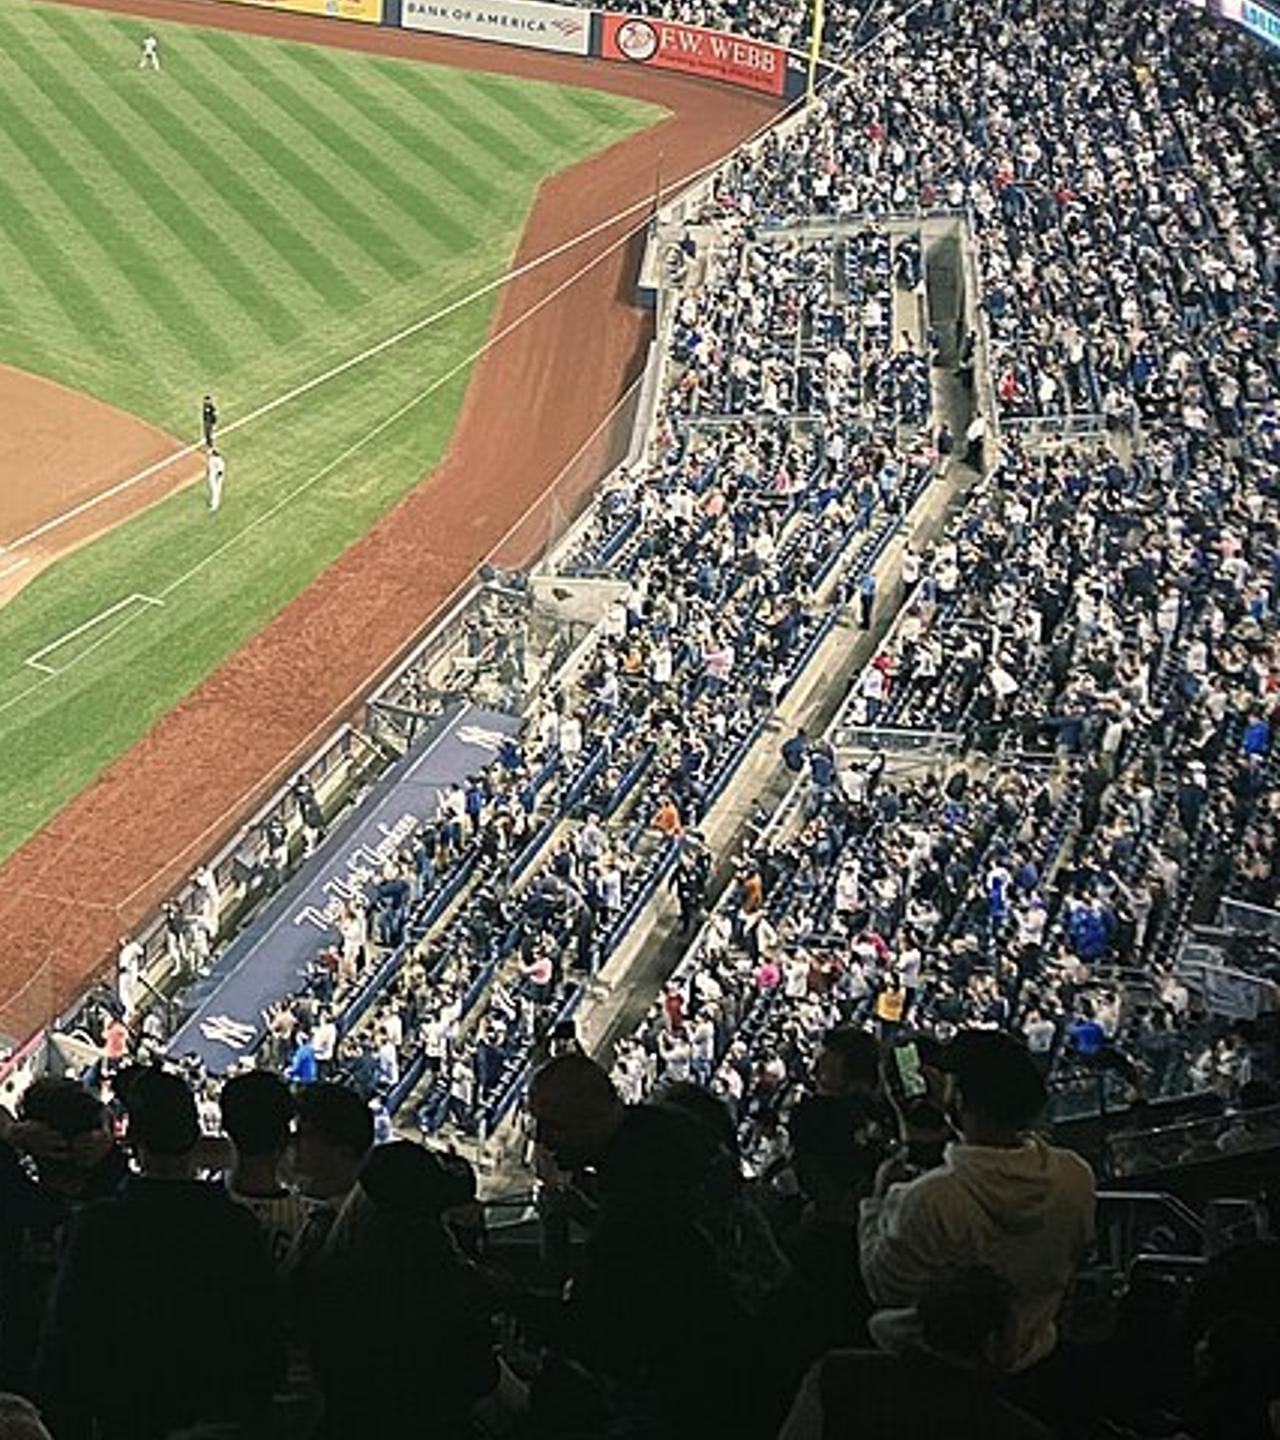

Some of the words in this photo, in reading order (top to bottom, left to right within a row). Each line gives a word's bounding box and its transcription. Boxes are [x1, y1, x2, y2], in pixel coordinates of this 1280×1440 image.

[407, 2, 447, 20] BANK
[451, 8, 471, 22] OF
[474, 10, 547, 33] AMERICA
[660, 26, 704, 56] F.W.
[709, 35, 777, 74] WEBB
